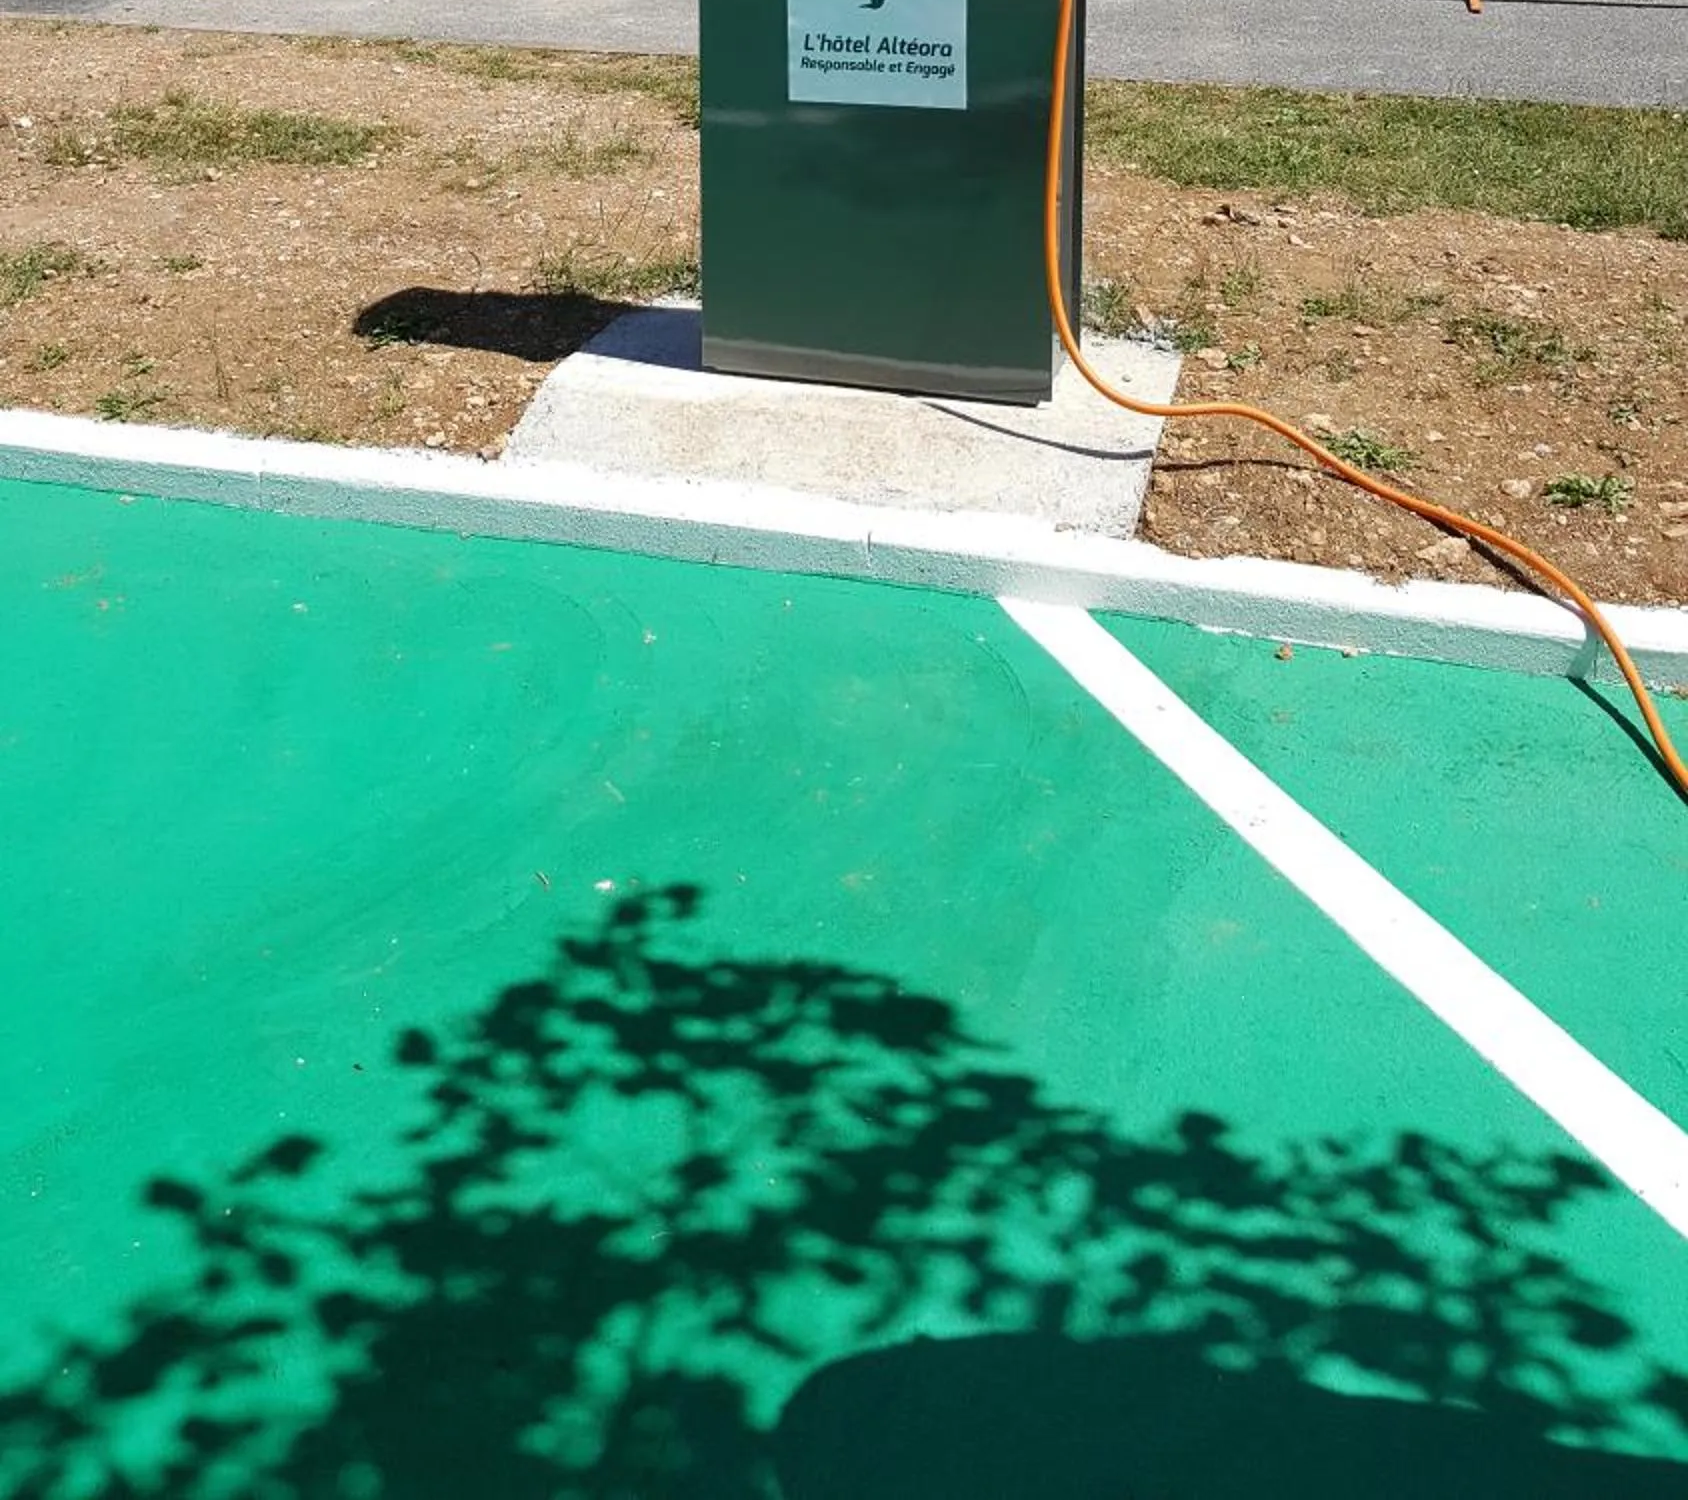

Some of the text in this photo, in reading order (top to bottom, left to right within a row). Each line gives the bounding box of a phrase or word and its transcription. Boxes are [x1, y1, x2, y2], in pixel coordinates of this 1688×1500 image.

[876, 35, 953, 58] Altéora
[800, 56, 956, 79] Responsable et Engagé
